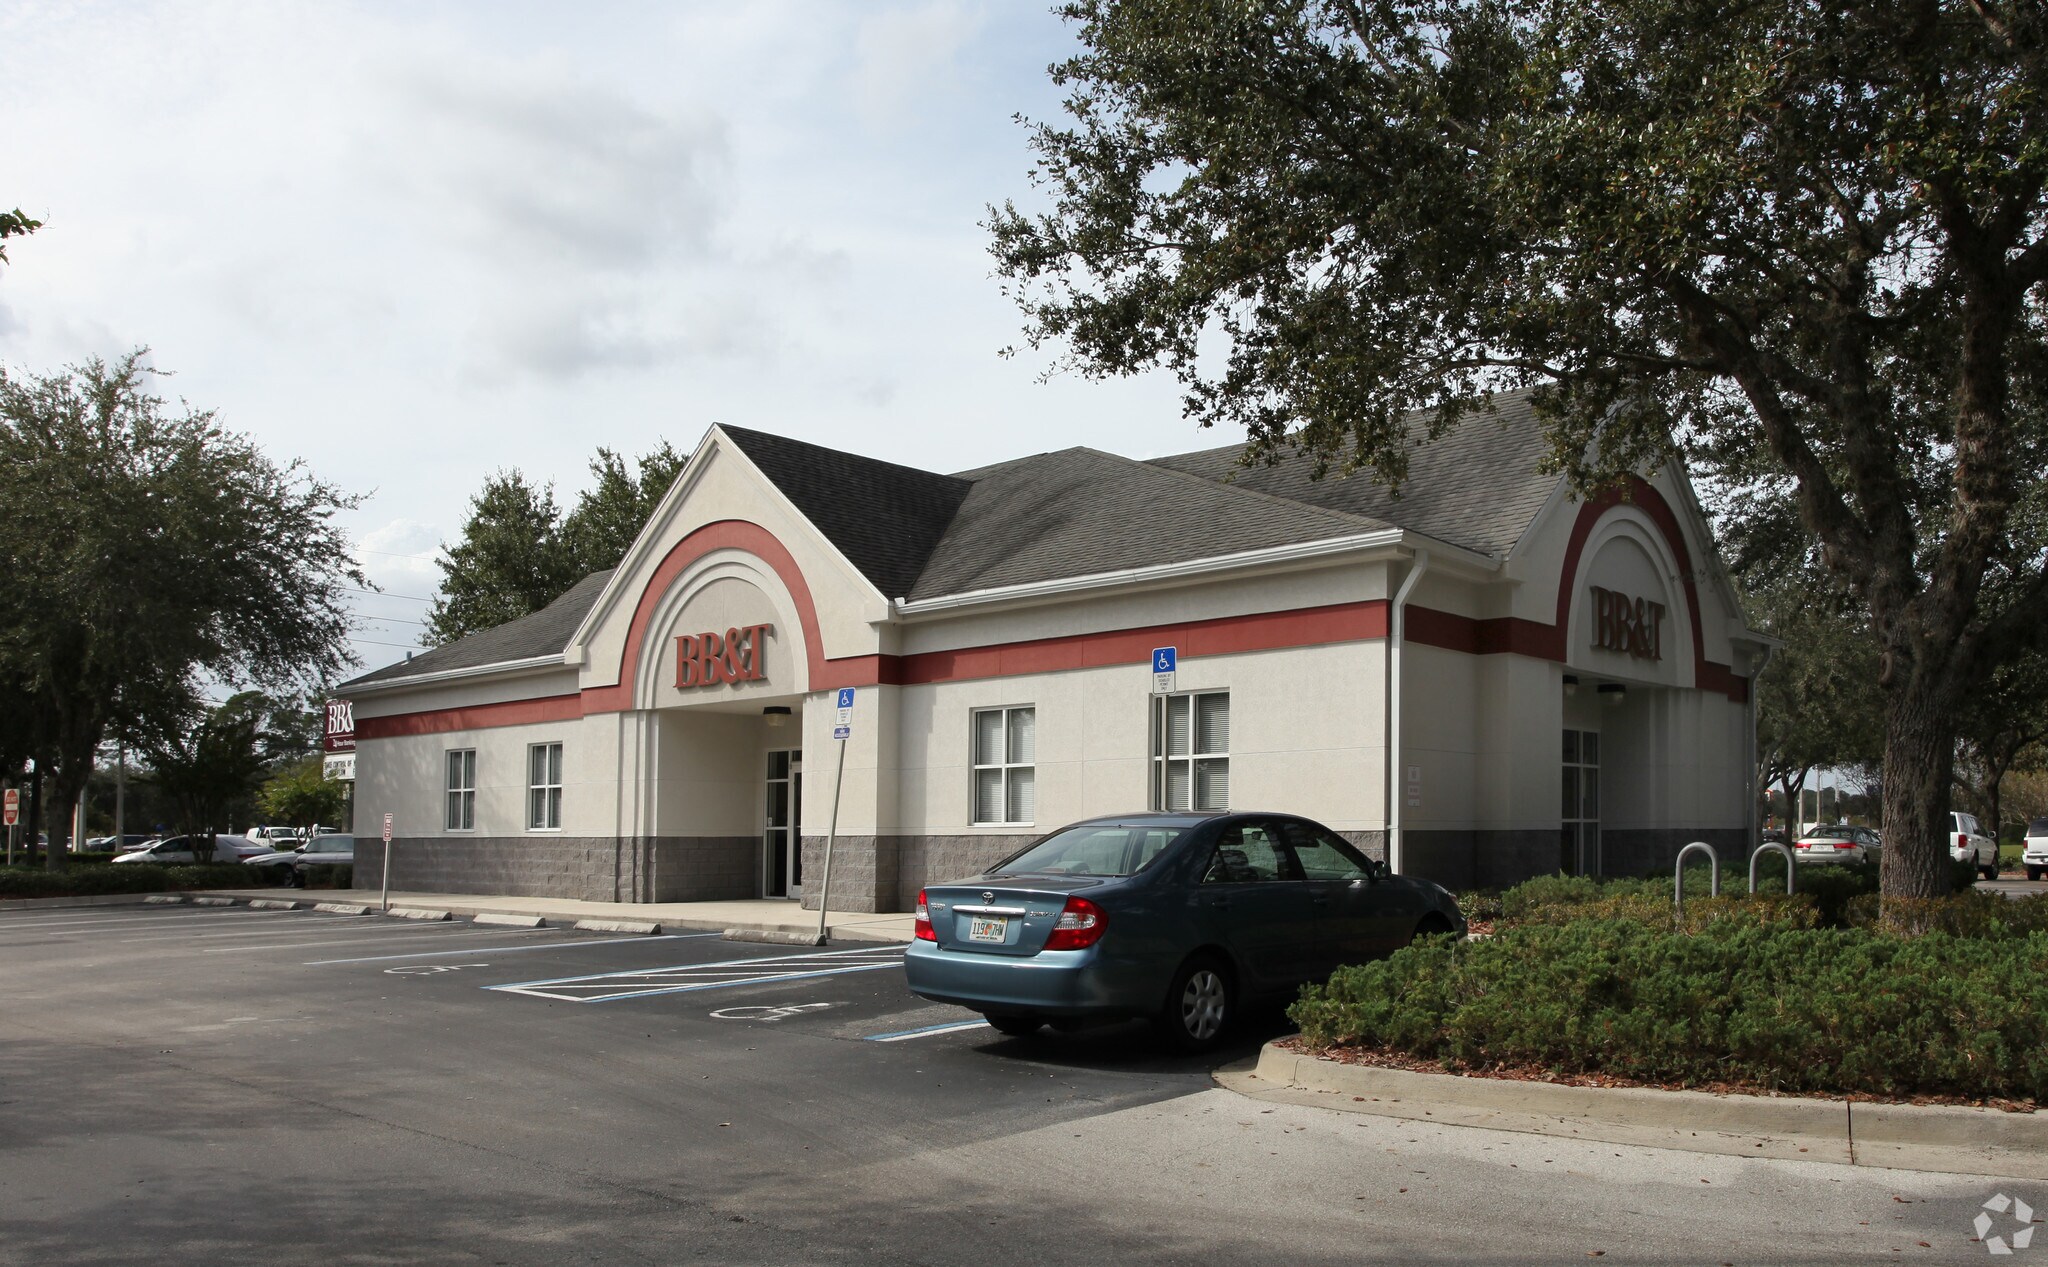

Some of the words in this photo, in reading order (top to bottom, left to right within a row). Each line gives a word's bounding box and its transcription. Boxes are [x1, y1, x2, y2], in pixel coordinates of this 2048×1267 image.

[673, 623, 772, 689] BB&T
[1590, 585, 1665, 661] BB&T
[327, 702, 354, 734] BB&
